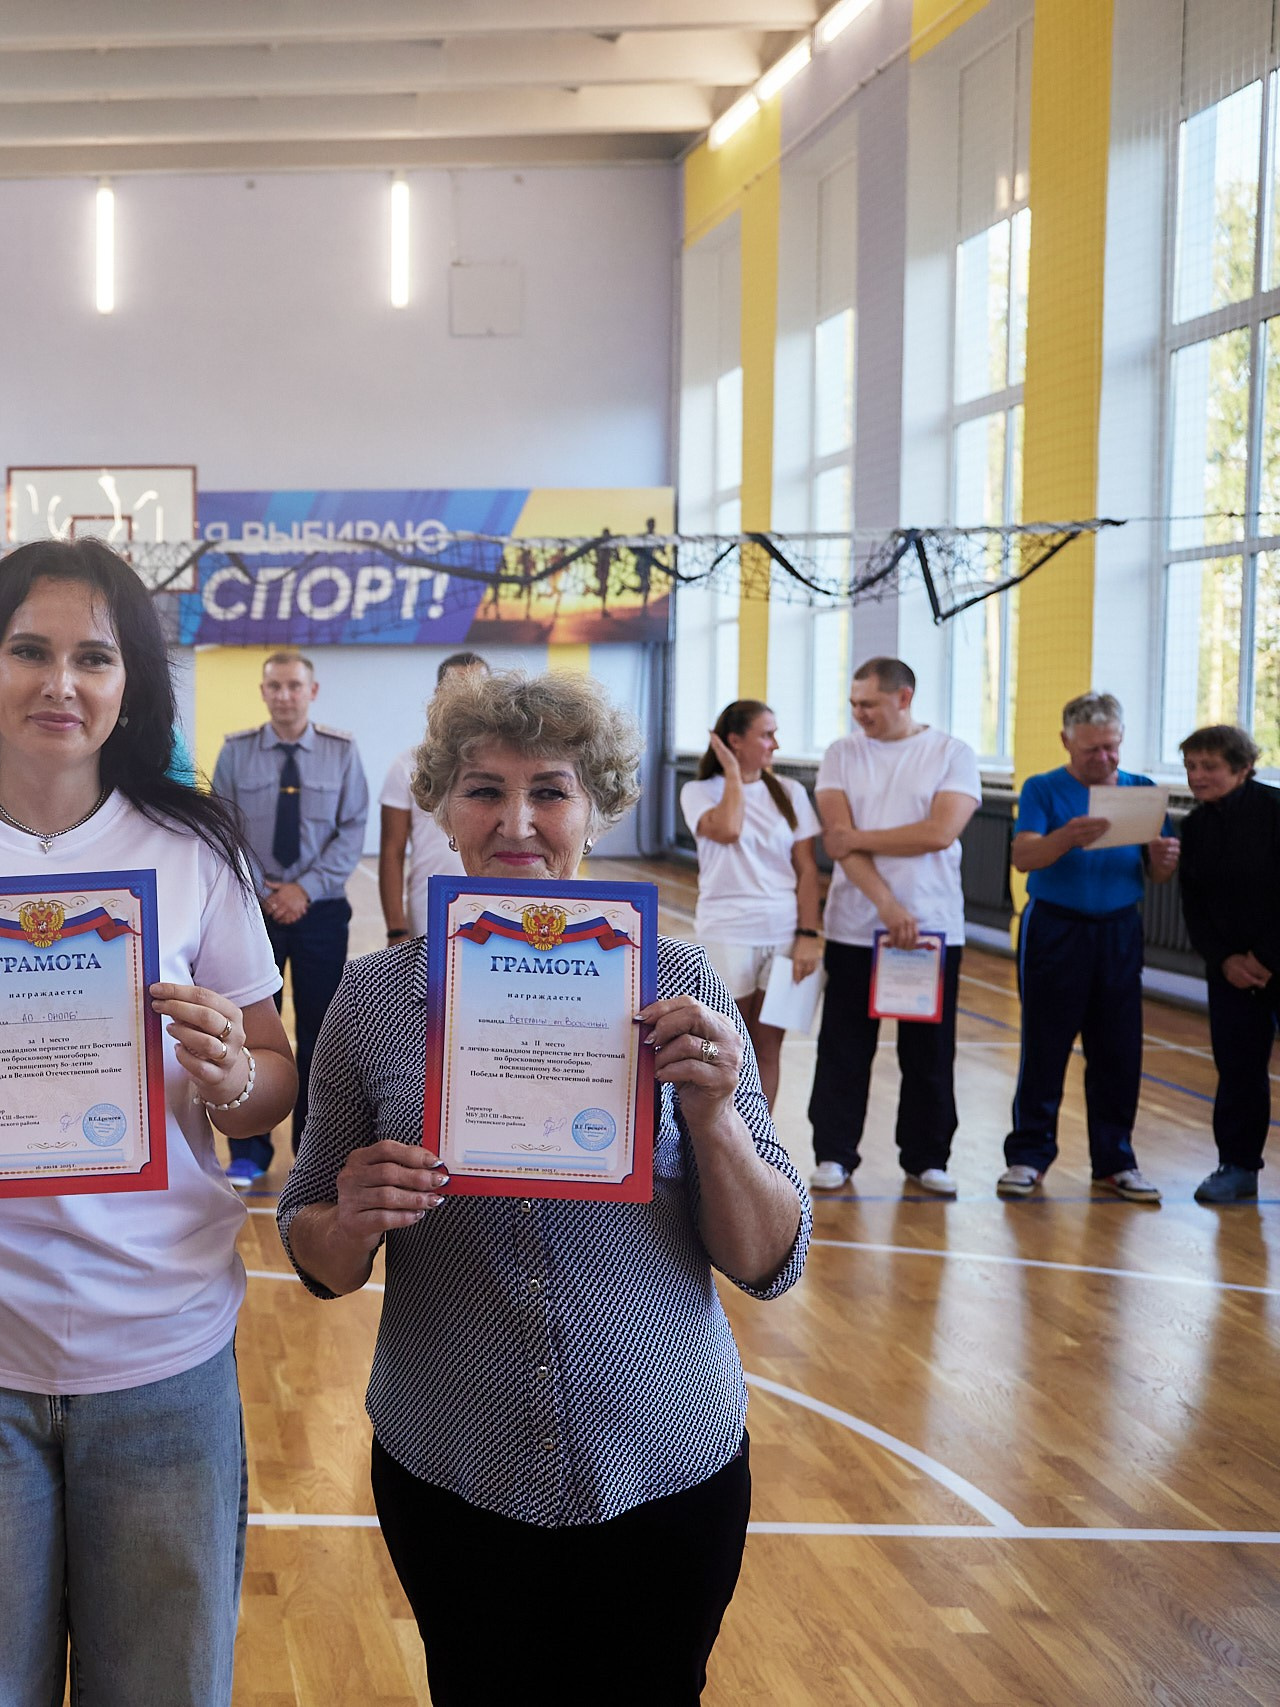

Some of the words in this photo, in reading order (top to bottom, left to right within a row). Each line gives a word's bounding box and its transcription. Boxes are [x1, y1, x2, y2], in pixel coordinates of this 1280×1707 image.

[204, 522, 230, 552] Я
[242, 518, 448, 554] ВЫБИРАЮ
[202, 566, 450, 620] СПОРТ!
[490, 956, 600, 977] ГРАМОТА
[8, 989, 84, 999] награждается
[507, 992, 582, 1002] награждается
[38, 1044, 78, 1053] первенстве
[92, 1041, 132, 1049] Восточный
[467, 1046, 531, 1055] лично-командном
[532, 1049, 572, 1058] первенстве
[586, 1051, 626, 1060] Восточный
[11, 1054, 52, 1064] бросковому
[54, 1051, 100, 1061] многоборью,
[504, 1055, 545, 1064] бросковому
[546, 1058, 593, 1067] многоборью,
[7, 1063, 59, 1071] посвященному
[14, 1070, 44, 1078] Великой
[45, 1068, 99, 1077] Отечественной
[499, 1064, 550, 1073] посвященному
[470, 1070, 498, 1078] Победы
[505, 1072, 535, 1080] Великой
[536, 1074, 590, 1083] Отечественной
